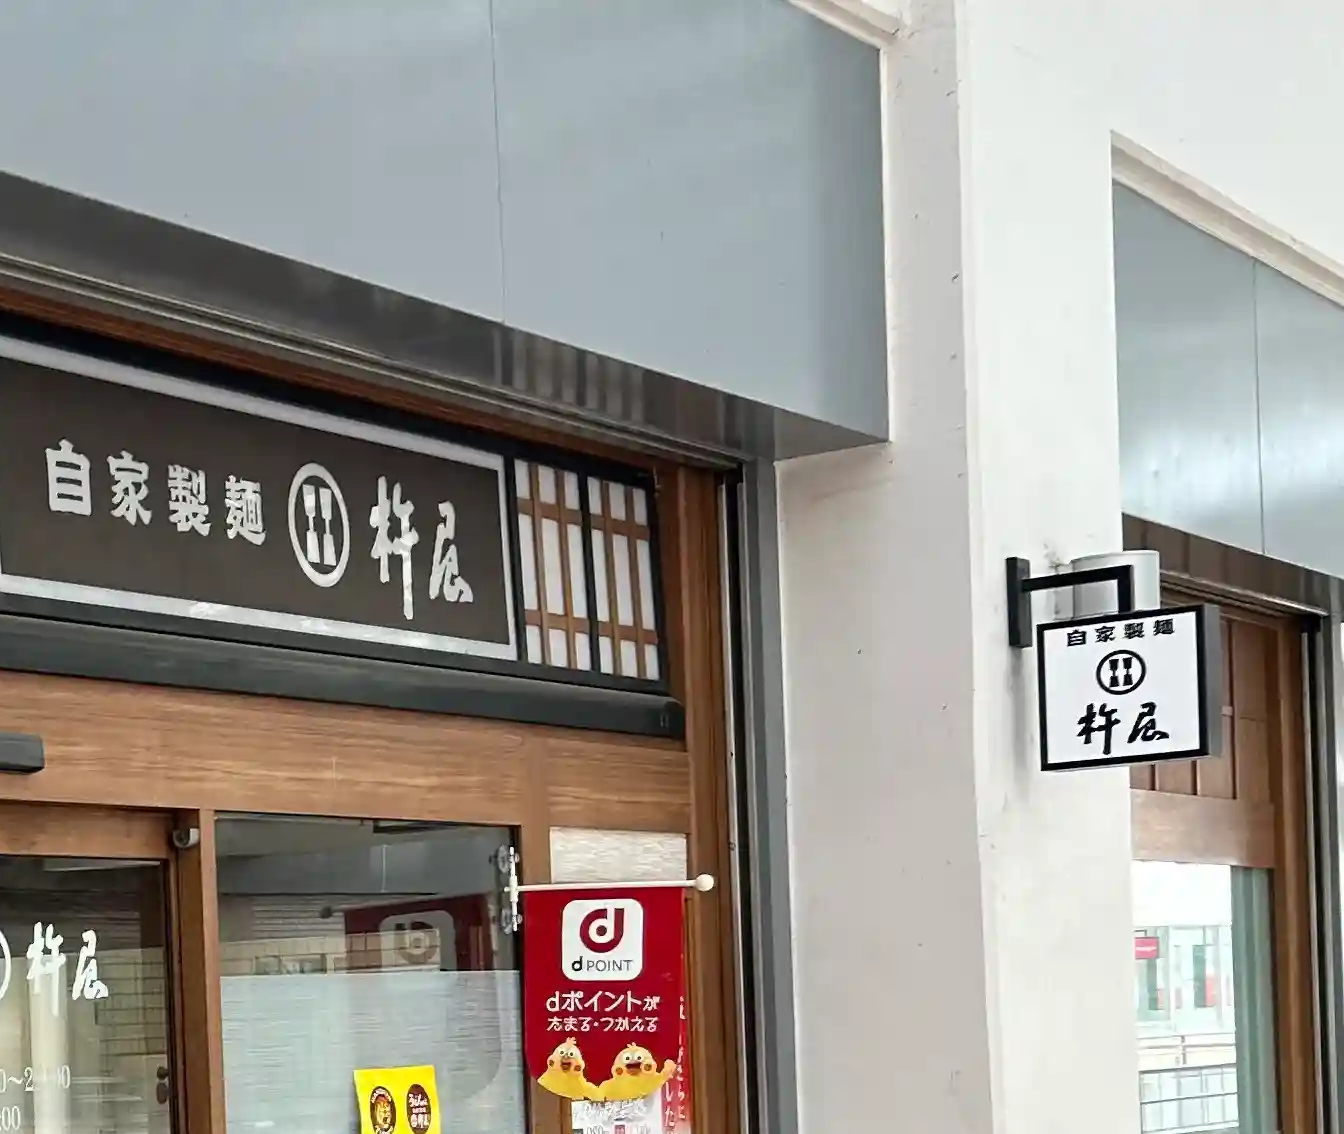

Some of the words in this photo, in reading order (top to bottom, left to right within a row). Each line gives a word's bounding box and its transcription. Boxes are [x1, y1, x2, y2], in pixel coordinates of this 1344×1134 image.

[44, 438, 268, 546] 自家製麺
[369, 474, 475, 621] 杵屋
[1066, 618, 1176, 648] 自家製麺
[1076, 701, 1170, 756] 杵屋
[26, 921, 110, 1018] 杵屋
[586, 959, 633, 972] POINT
[546, 990, 661, 1013] dポイントが
